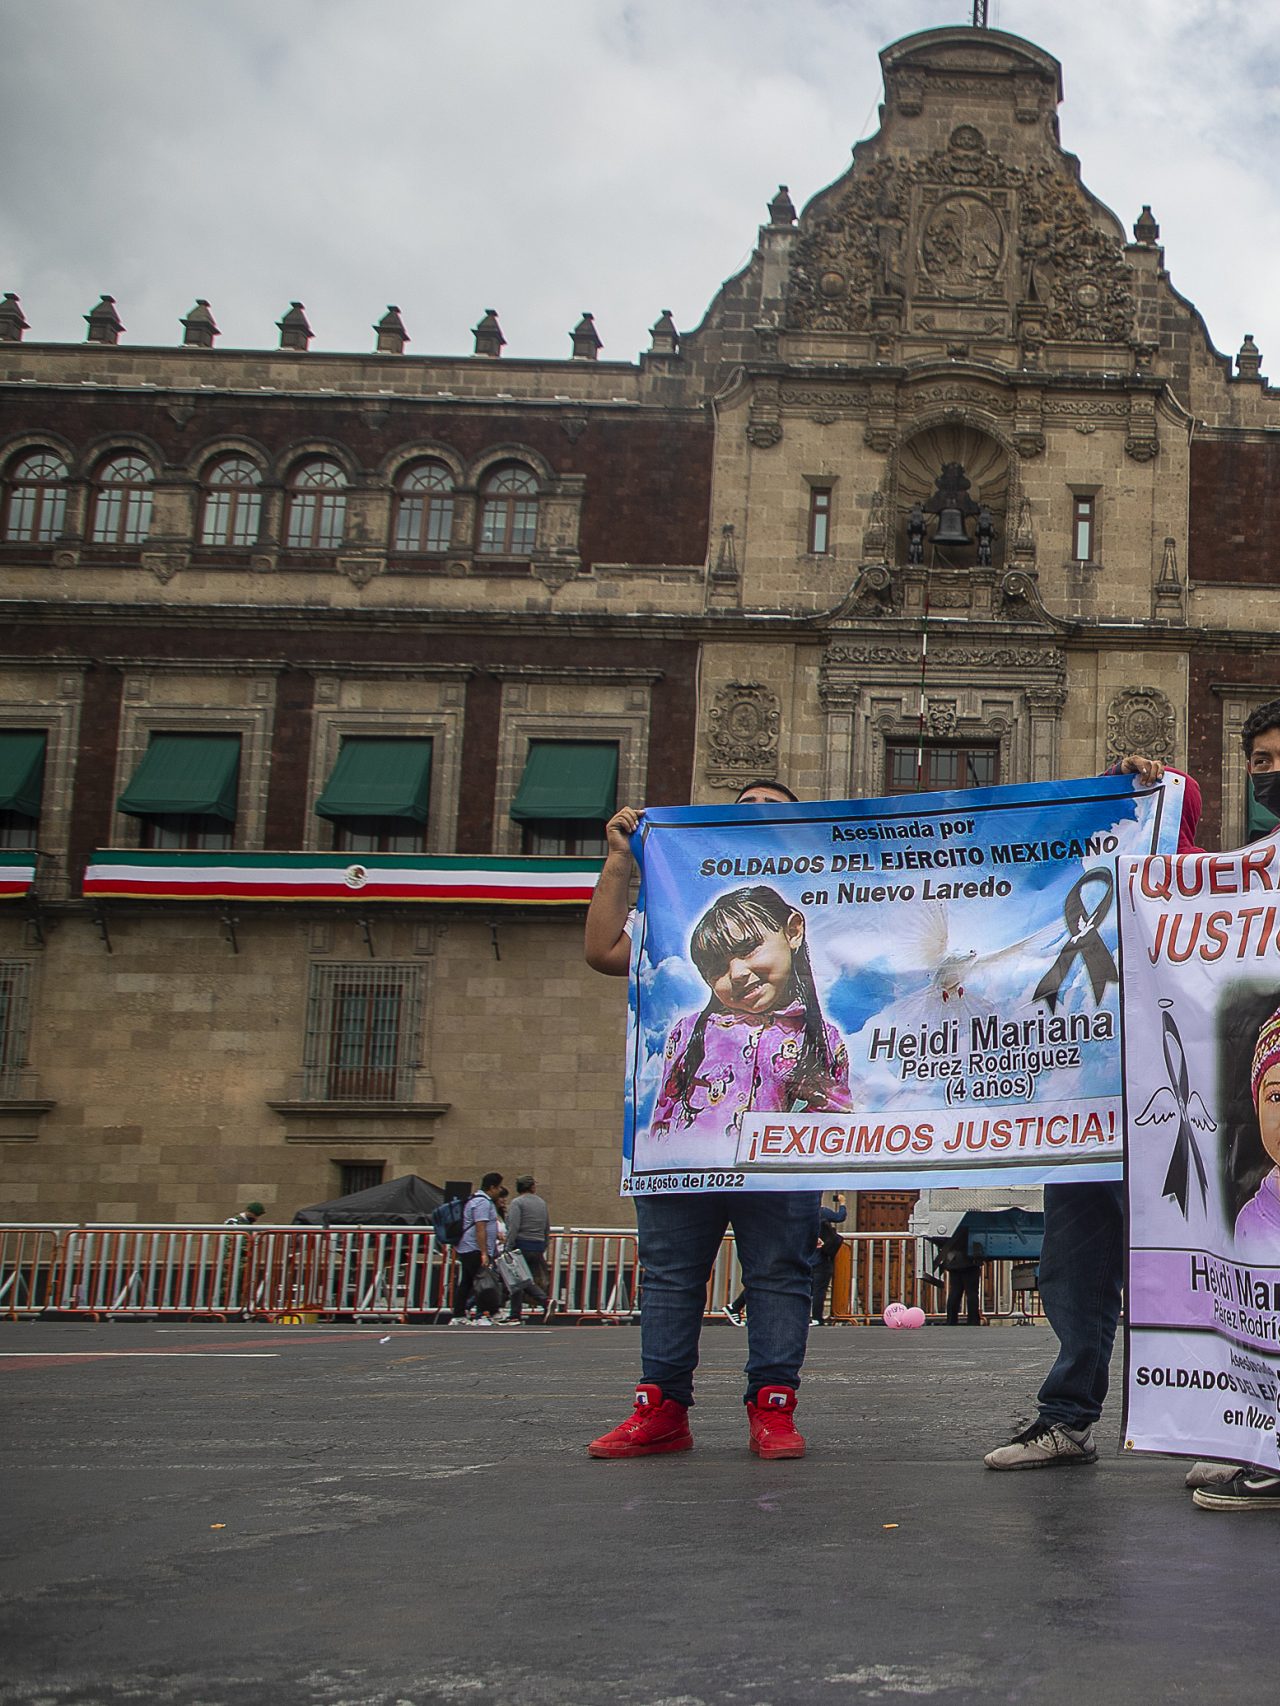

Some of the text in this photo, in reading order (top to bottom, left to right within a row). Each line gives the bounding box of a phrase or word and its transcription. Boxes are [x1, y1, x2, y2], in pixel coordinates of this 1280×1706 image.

[831, 818, 976, 843] Asesinada por
[699, 835, 1119, 877] SOLDADOS DEL EJÉRCITO MEXICANO
[800, 876, 1012, 906] en Nuevo Laredo
[870, 1010, 1113, 1061] Heidi Mariana
[901, 1046, 1080, 1080] Pérez Rodríguez
[945, 1076, 1035, 1105] (4 años)
[749, 1112, 1116, 1160] ¡EXIGIMOS JUSTICIA!
[635, 1177, 645, 1190] de
[647, 1175, 678, 1192] Agosto
[682, 1174, 705, 1188] del
[707, 1173, 745, 1188] 2022
[1190, 1255, 1234, 1302] Heidi
[1213, 1299, 1238, 1330] Pérez
[1136, 1366, 1238, 1392] SOLDADOS
[1236, 1376, 1261, 1399] DEL
[1223, 1409, 1244, 1426] en
[1246, 1406, 1276, 1431] Nue
